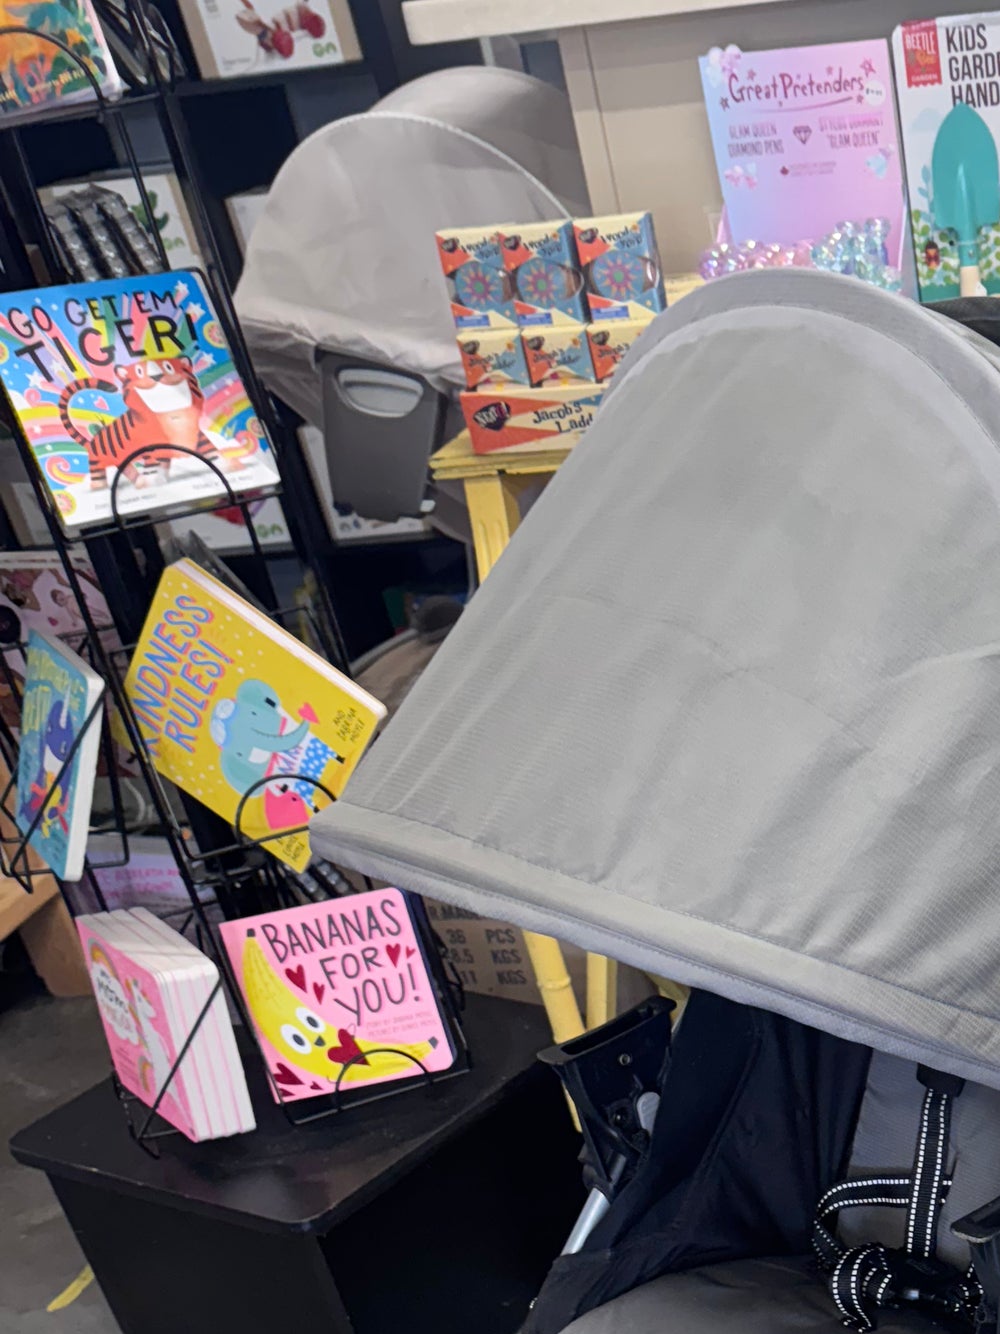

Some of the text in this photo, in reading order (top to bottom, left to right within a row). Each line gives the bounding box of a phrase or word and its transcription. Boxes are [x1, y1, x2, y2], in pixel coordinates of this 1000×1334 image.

[905, 31, 937, 56] BEETLE
[945, 23, 988, 54] KIDS
[728, 66, 865, 103] Great Pretenders
[951, 80, 1000, 109] HAND
[764, 139, 785, 154] PENS
[7, 306, 52, 339] GO
[64, 295, 121, 327] GET
[15, 306, 200, 382] TIGER!
[532, 401, 583, 425] Jacob's
[163, 639, 235, 754] RULES!
[260, 899, 403, 964] BANANAS
[484, 928, 516, 944] PCS
[320, 946, 384, 990] FOR
[490, 948, 522, 964] KGS
[496, 969, 527, 985] KGS
[334, 969, 421, 1026] YOU!
